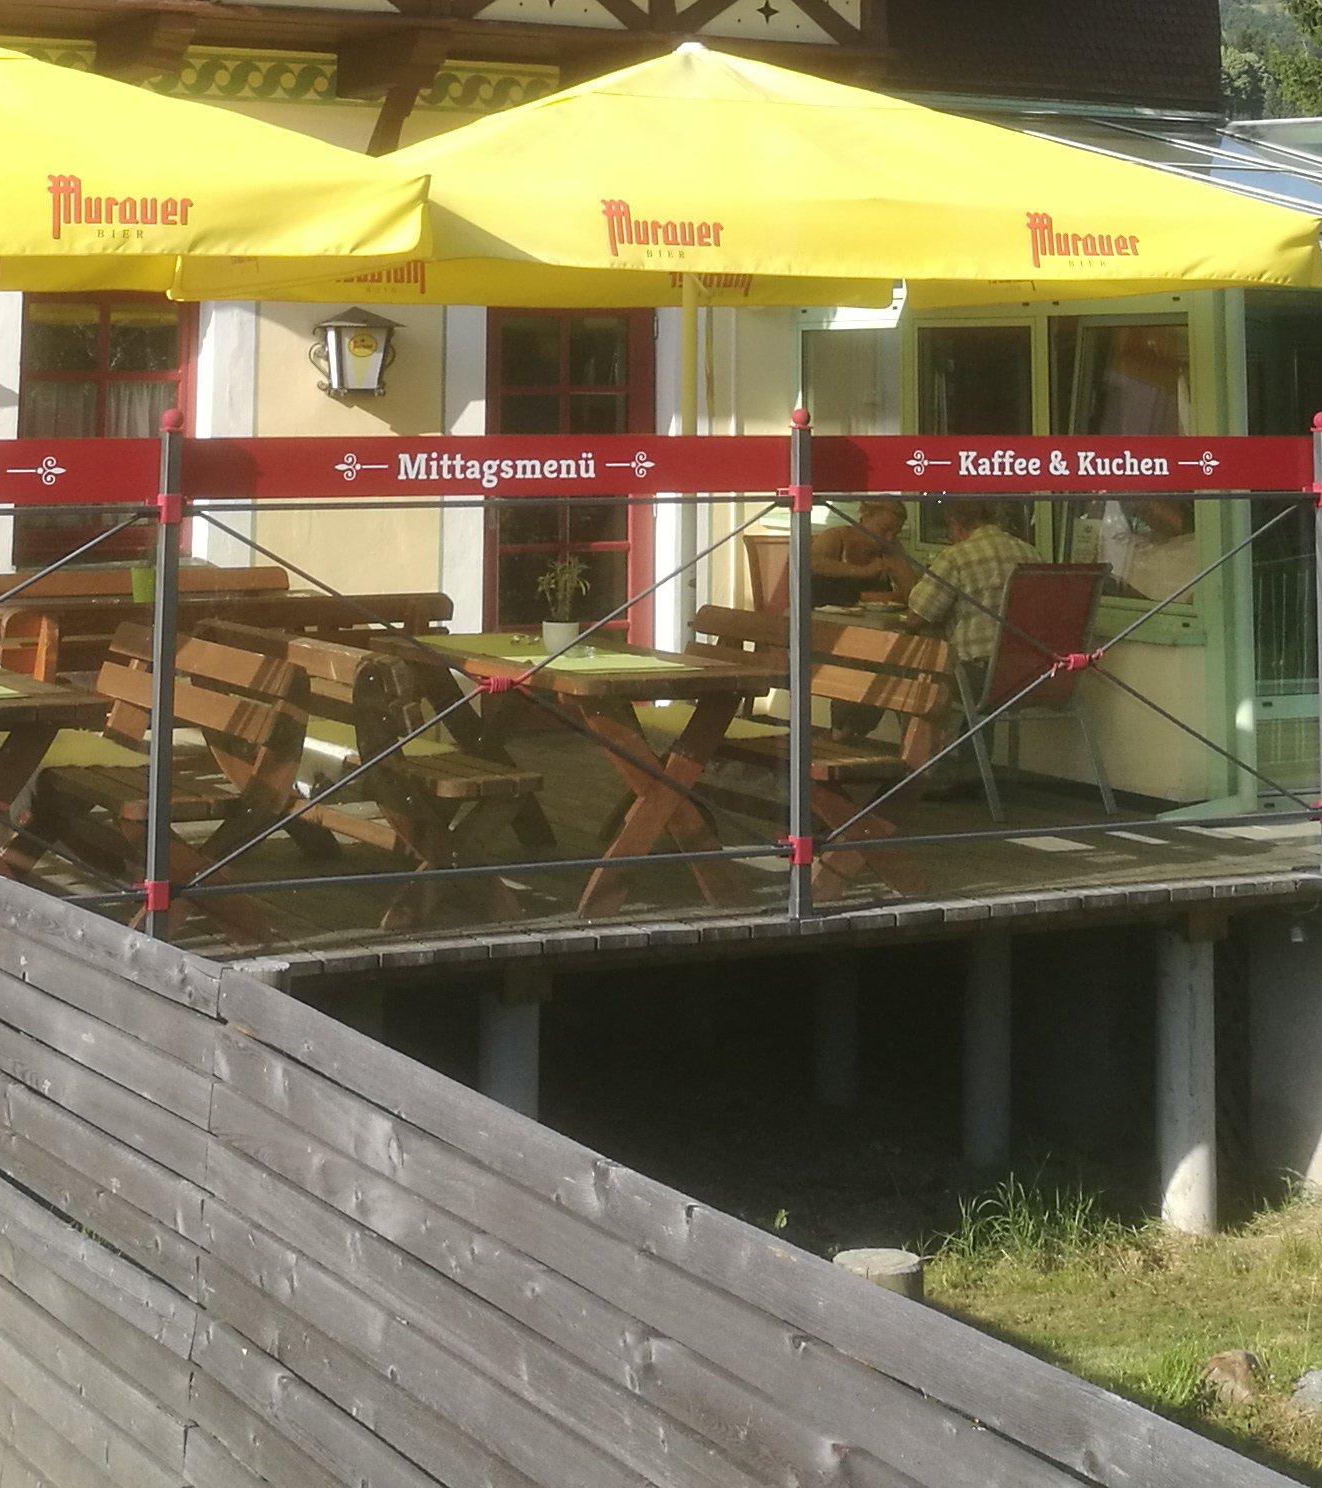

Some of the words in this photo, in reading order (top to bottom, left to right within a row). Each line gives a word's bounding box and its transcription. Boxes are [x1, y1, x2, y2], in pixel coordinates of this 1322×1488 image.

[47, 174, 194, 240] Murauer
[600, 199, 725, 257] Murauer
[97, 229, 144, 239] BIER
[1026, 212, 1140, 269] Murauer
[397, 451, 596, 489] Mittagsmenü
[958, 449, 1041, 476] Kaffee
[1049, 450, 1071, 476] &
[1077, 450, 1170, 476] Kuchen
